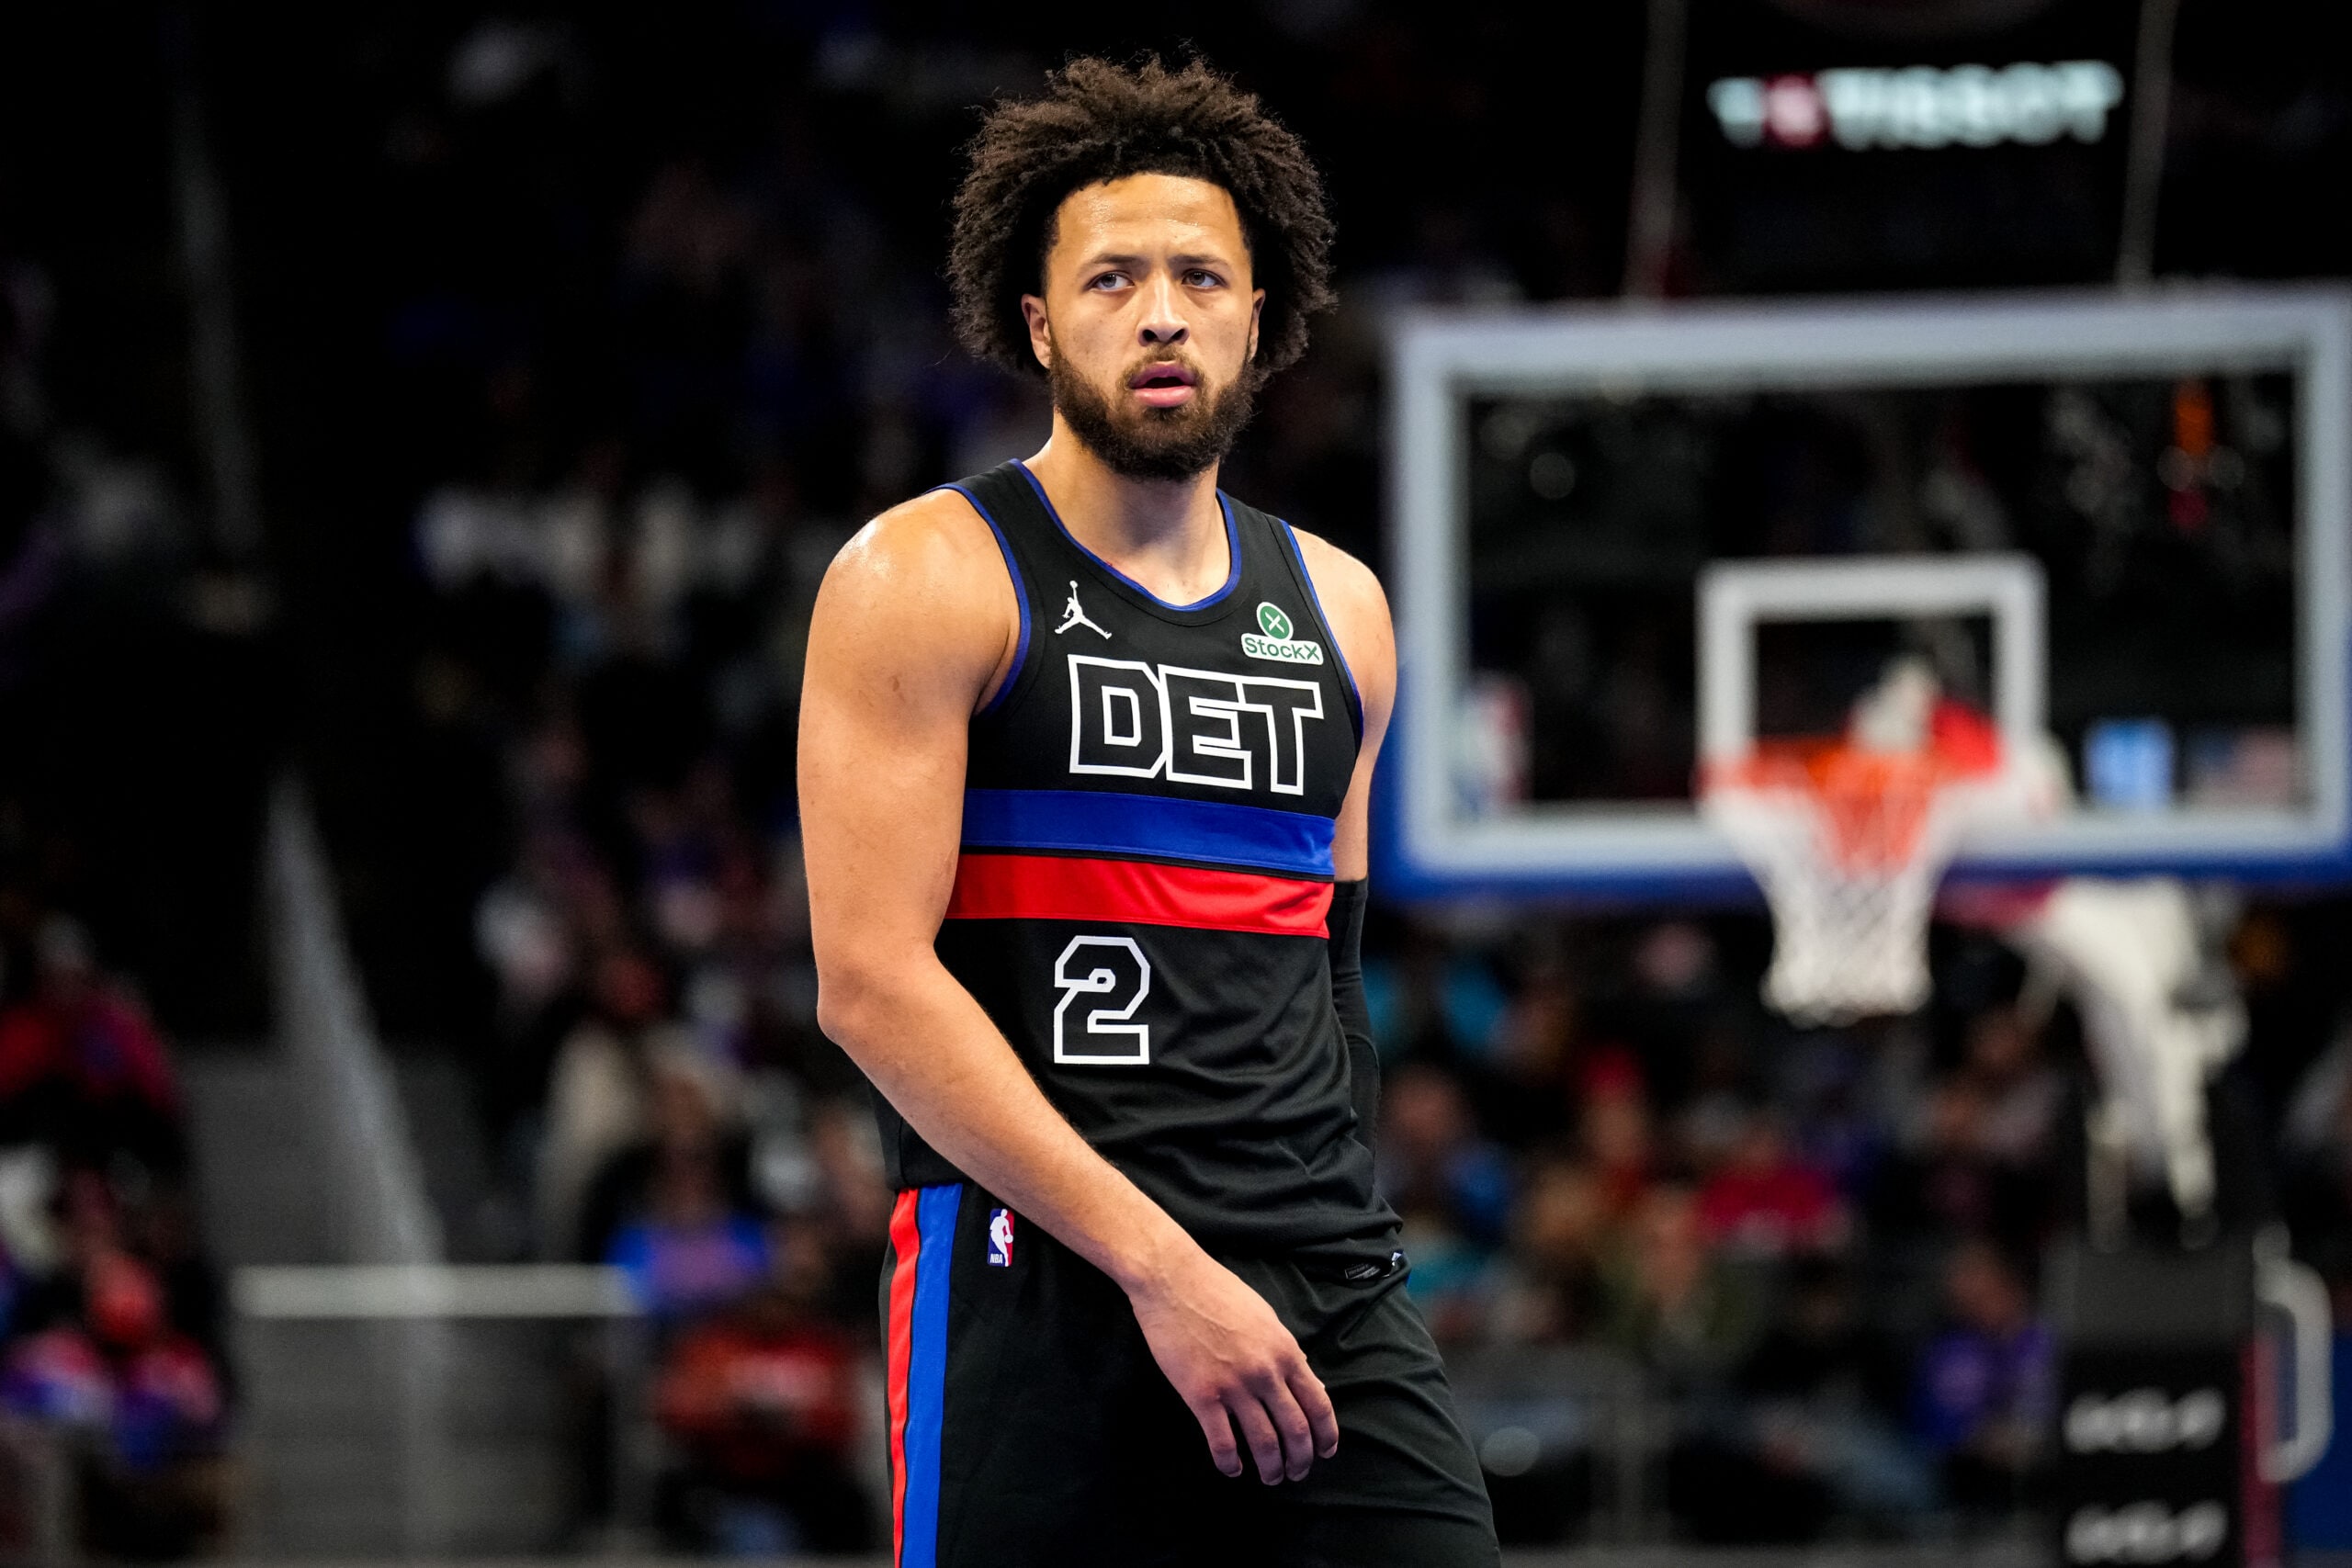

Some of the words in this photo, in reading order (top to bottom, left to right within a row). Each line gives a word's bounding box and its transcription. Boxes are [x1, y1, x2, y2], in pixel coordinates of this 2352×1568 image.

[1244, 637, 1320, 661] StockX
[1068, 654, 1324, 795] DET
[1054, 935, 1150, 1065] 2
[989, 1253, 1003, 1264] NBA
